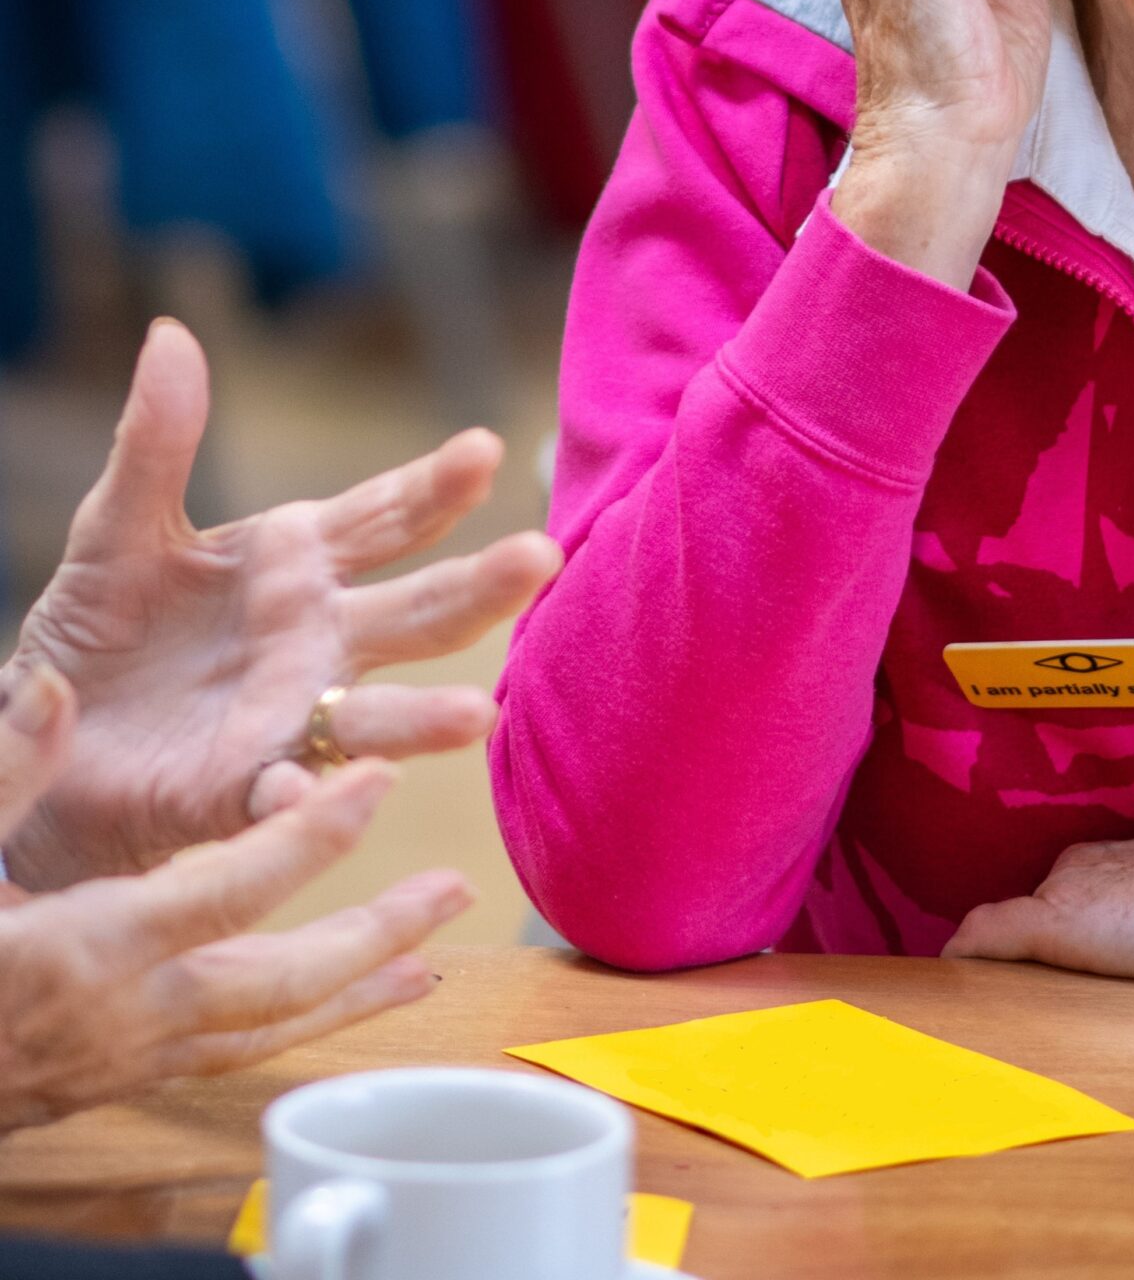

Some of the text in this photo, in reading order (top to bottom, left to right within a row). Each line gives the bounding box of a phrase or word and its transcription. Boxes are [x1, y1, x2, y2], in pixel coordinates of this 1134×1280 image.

[970, 684, 981, 696] I
[987, 686, 1022, 696] am
[1028, 683, 1120, 698] partially
